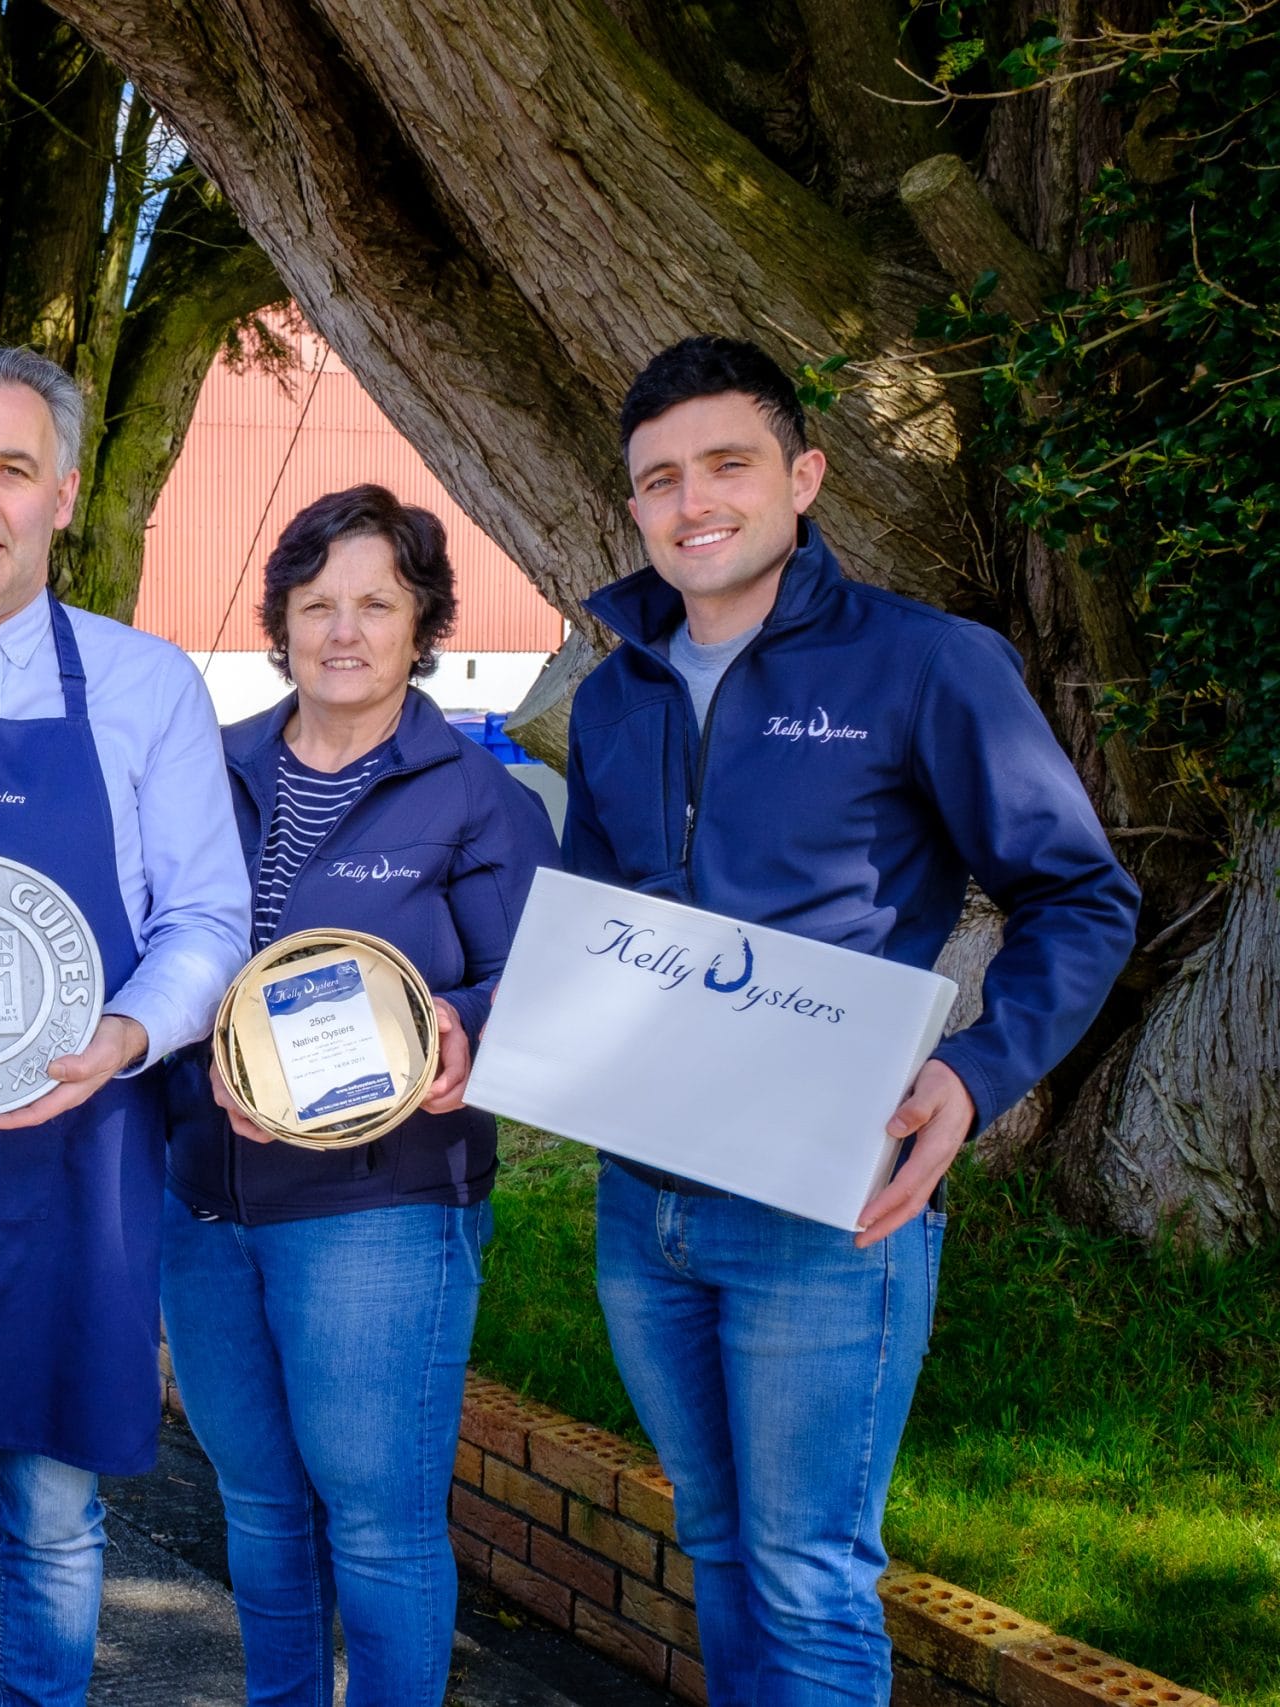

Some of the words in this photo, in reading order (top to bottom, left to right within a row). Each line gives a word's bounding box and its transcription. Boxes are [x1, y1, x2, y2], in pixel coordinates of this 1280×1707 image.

[763, 716, 806, 742] Kelly
[327, 861, 369, 883] Kelly
[9, 881, 90, 1007] GUIDES
[585, 918, 697, 991] Kelly
[271, 987, 302, 1003] Kelly
[308, 1014, 336, 1027] 25pcs
[292, 1034, 320, 1048] Native
[321, 1025, 355, 1040] Oysters
